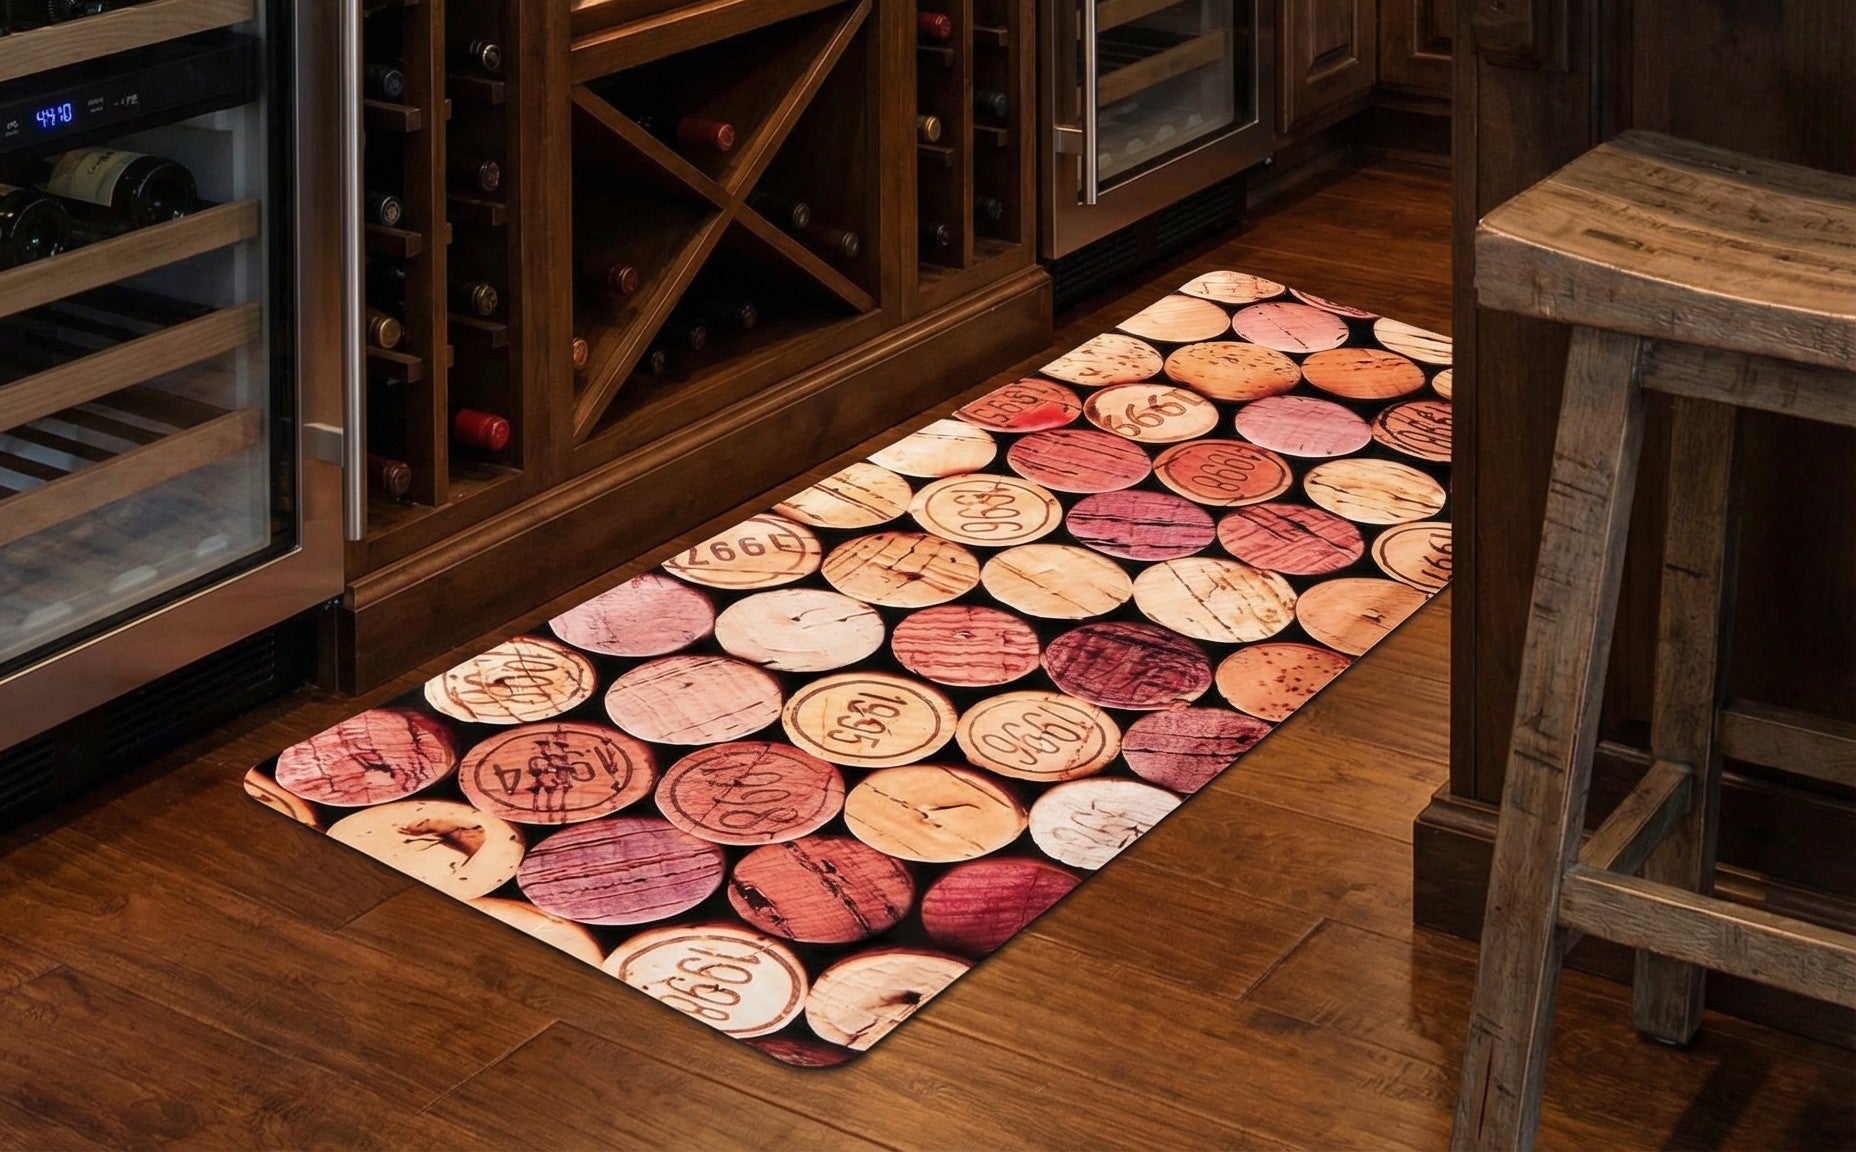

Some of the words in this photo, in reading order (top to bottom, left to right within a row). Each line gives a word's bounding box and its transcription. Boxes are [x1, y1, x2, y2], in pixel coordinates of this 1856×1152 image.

[1191, 447, 1263, 493] 1998
[827, 692, 908, 749] 1995
[982, 705, 1088, 766] 1996
[658, 947, 761, 1022] 1998
